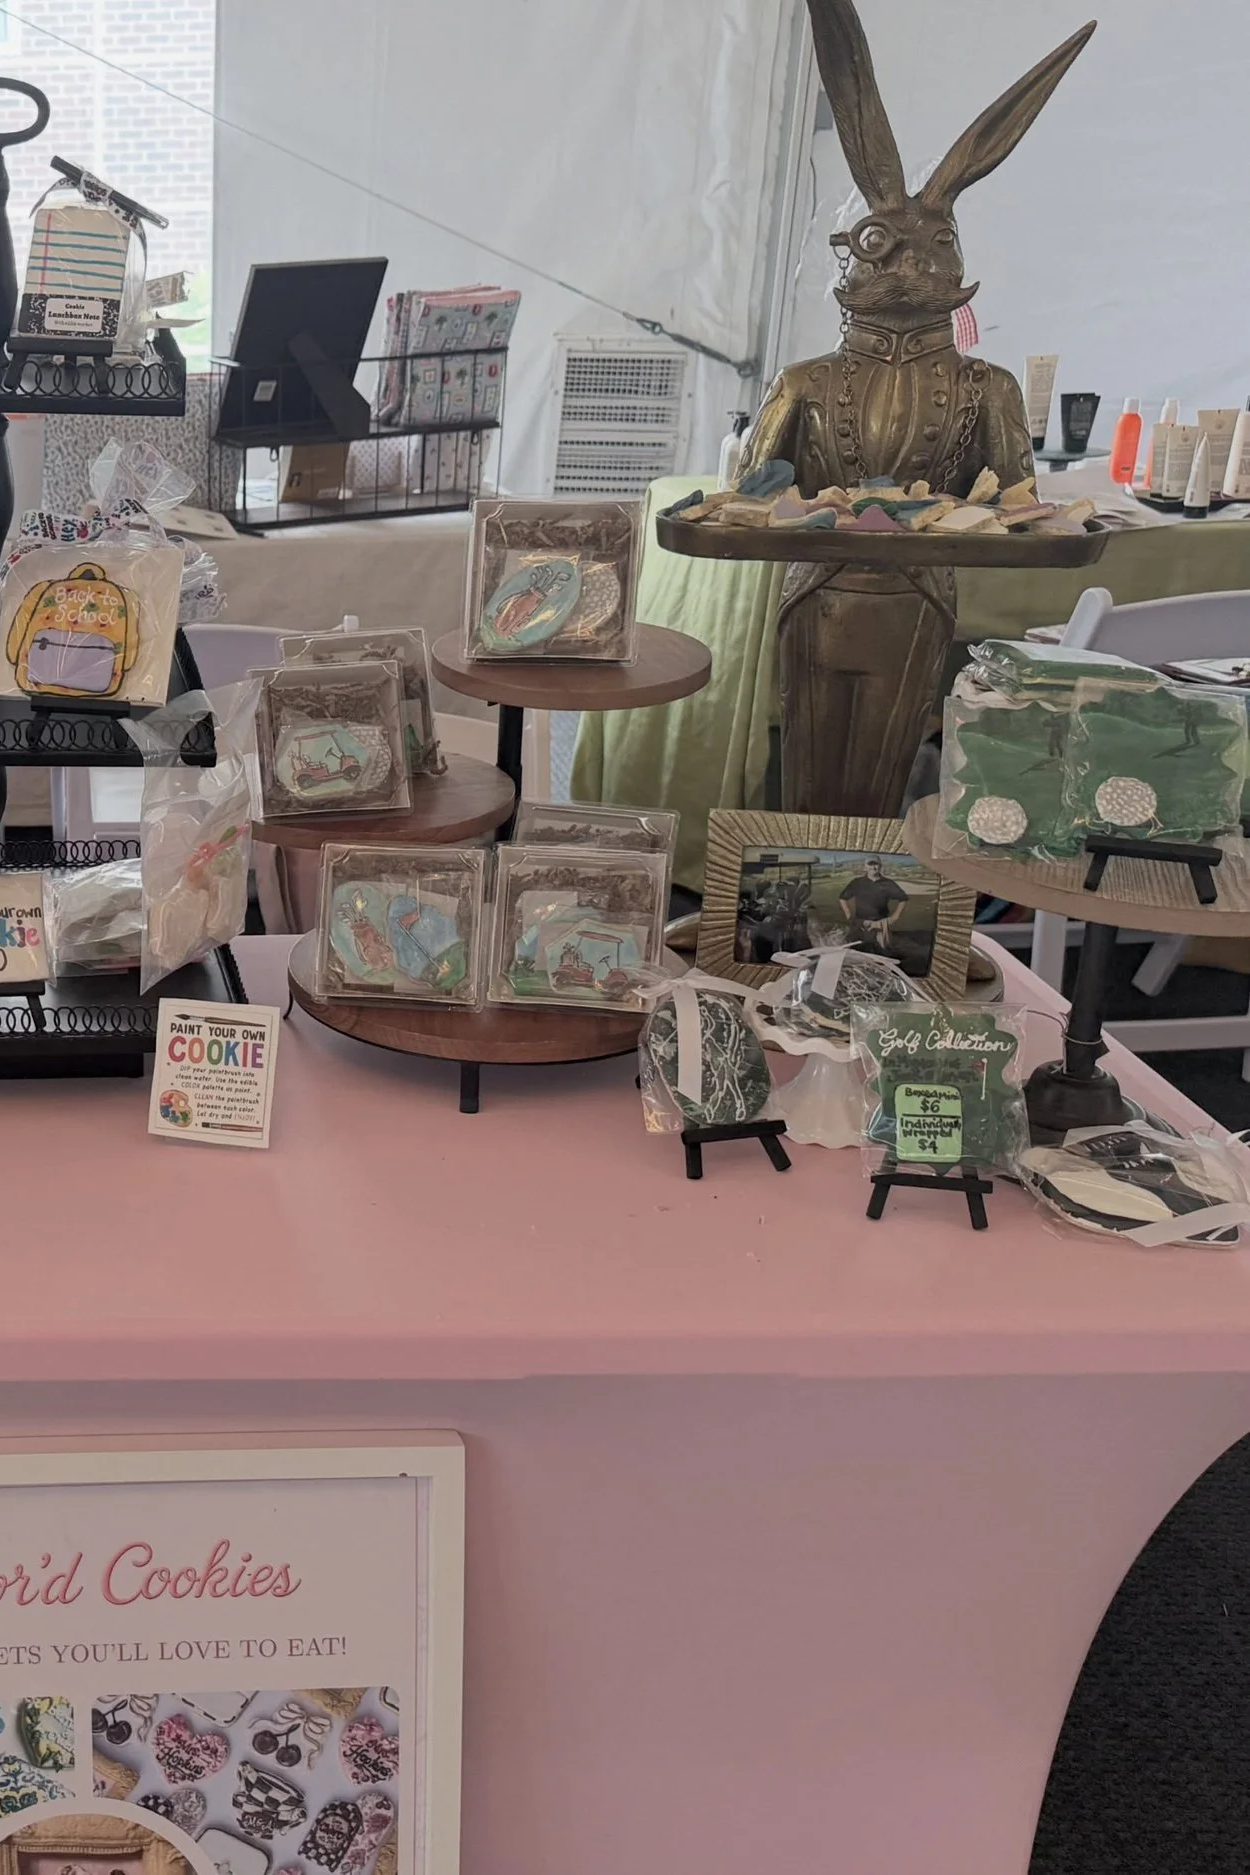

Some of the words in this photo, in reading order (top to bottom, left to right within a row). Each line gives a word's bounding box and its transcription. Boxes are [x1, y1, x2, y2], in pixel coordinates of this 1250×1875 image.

[48, 311, 82, 319] Lunchbox
[54, 586, 95, 605] Back
[99, 591, 118, 606] to
[54, 604, 118, 625] School
[16, 906, 42, 918] own
[170, 1022, 202, 1035] PAINT
[209, 1026, 236, 1039] YOUR
[242, 1029, 266, 1041] OWN
[878, 1028, 922, 1056] Golf
[925, 1029, 1014, 1052] Collection
[168, 1035, 265, 1069] COOKIE
[197, 1102, 221, 1110] between
[209, 1111, 219, 1119] dry
[920, 1099, 941, 1114] $6
[918, 1139, 939, 1154] $4
[102, 1538, 302, 1606] Cookies
[50, 1641, 149, 1664] YOU'LL
[158, 1639, 231, 1661] LOVE
[239, 1638, 278, 1659] TO
[287, 1636, 347, 1658] EAT!
